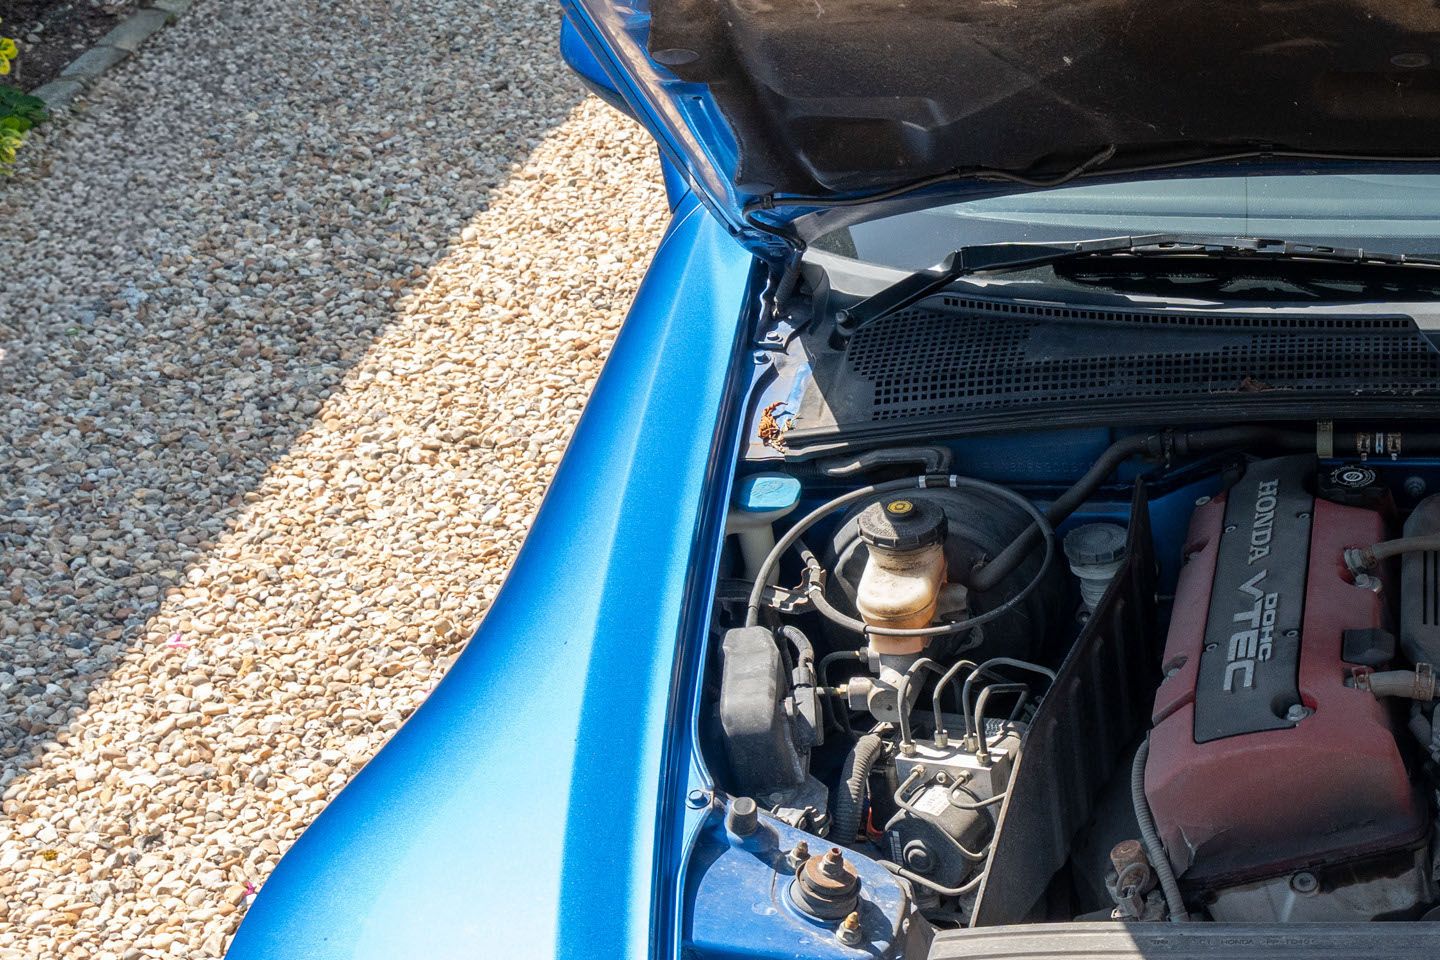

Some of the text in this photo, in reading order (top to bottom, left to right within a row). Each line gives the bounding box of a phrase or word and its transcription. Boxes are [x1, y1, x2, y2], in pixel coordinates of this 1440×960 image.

[1223, 478, 1279, 692] HONDA VTEC
[1258, 592, 1279, 662] DOHC
